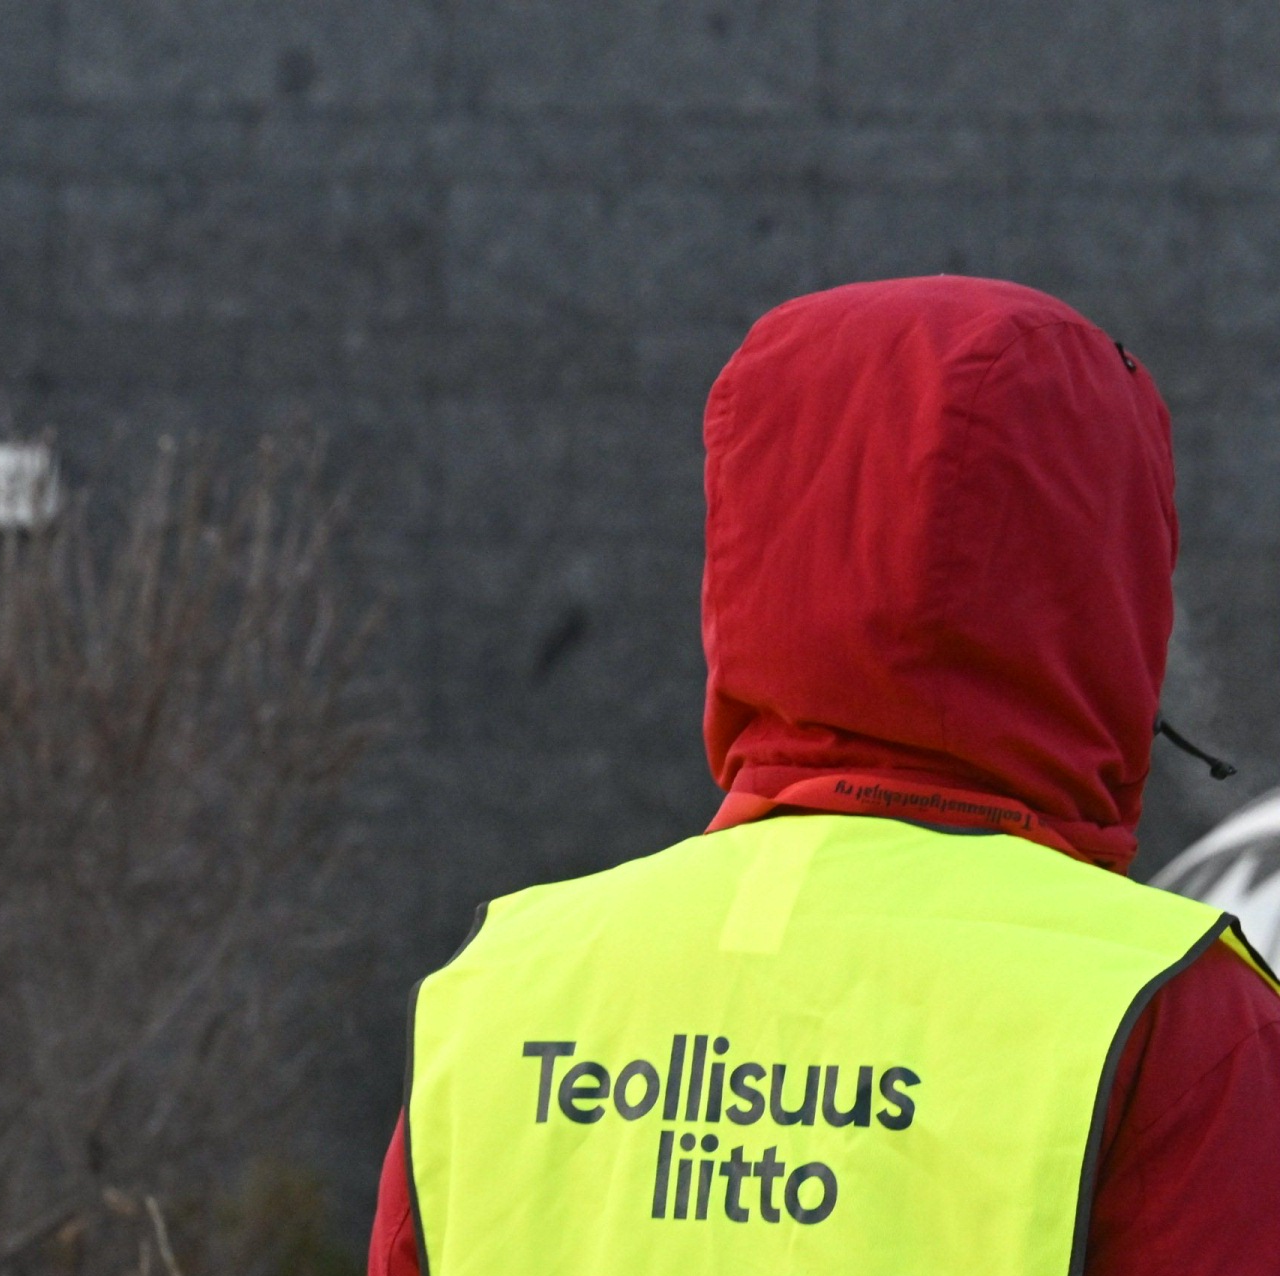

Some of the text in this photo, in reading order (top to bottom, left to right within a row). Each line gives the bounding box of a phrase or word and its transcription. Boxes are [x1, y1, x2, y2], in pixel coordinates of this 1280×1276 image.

[834, 779, 854, 795] ry
[521, 1034, 923, 1131] Teollisuus
[651, 1130, 839, 1226] liitto
